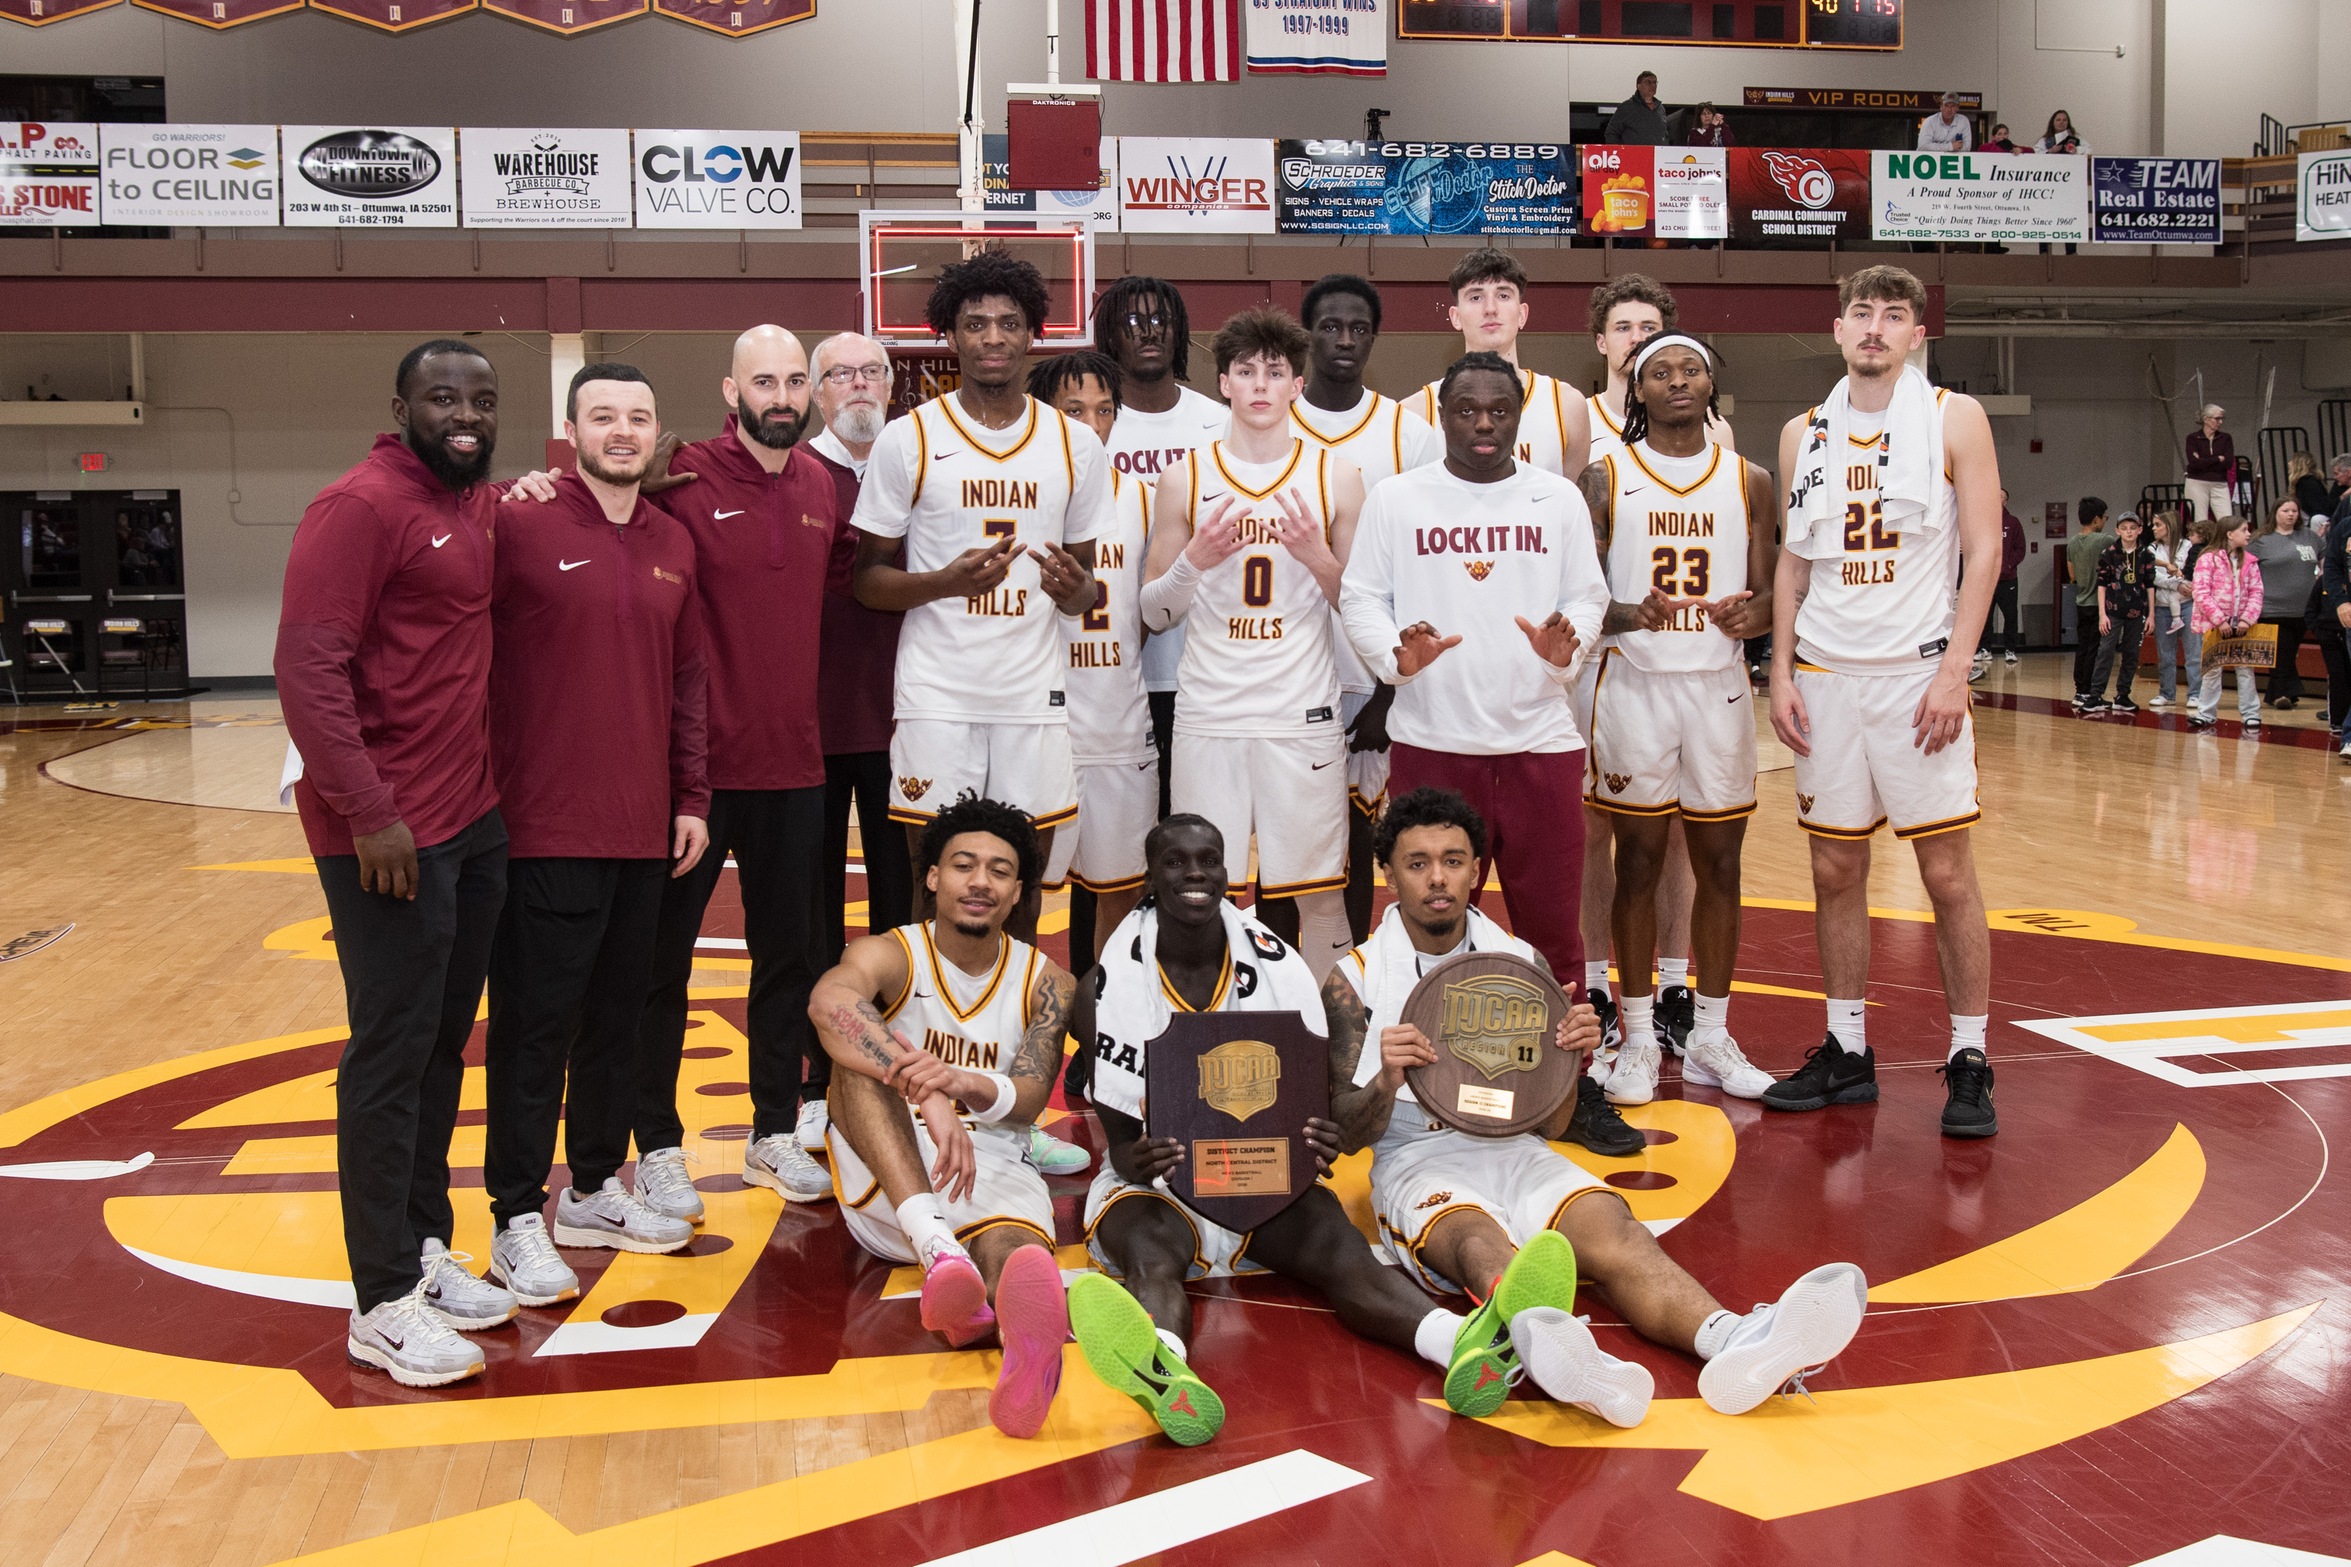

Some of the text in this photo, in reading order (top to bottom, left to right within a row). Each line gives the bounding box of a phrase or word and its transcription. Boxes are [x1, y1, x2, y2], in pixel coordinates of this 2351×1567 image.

[1283, 15, 1348, 36] 1997-1999
[1808, 92, 1919, 106] VIP ROOM
[152, 133, 226, 142] GO WARRIORS!
[0, 149, 91, 159] HALT PAVING
[107, 147, 219, 170] FLOOR
[328, 147, 410, 161] DOWNTOWN
[1305, 142, 1559, 159] 641-682-6889
[1589, 150, 1621, 168] olé
[494, 153, 599, 176] WAREHOUSE
[642, 145, 795, 183] CLOW
[1289, 163, 1386, 179] SCHROEDER
[1515, 165, 1534, 174] THE
[1888, 154, 2071, 183] NOEL Insurance
[329, 166, 411, 183] FITNESS
[1658, 168, 1685, 178] taco
[2137, 160, 2217, 189] TEAM
[108, 179, 273, 201] to CEILING
[516, 178, 579, 189] BARBECUE CO.
[1127, 178, 1268, 203] WINGER
[1309, 178, 1357, 191] Graphics
[1489, 176, 1567, 202] Stitch Doctor
[1804, 177, 1824, 201] C
[13, 185, 93, 212] STONE
[646, 188, 795, 214] VALVE CO.
[986, 193, 1026, 204] ERNET
[1285, 197, 1384, 206] SIGNS VEHICLE WRAPS
[1610, 197, 1638, 207] taco
[1907, 187, 2055, 201] A Proud Sponsor of IHCC!
[2099, 190, 2215, 208] Real Estate
[112, 208, 269, 217] INTERIOR DESIGN SHOWROOM
[289, 204, 452, 214] 203 W 4th St Ottumwa, IA 52501
[496, 199, 601, 209] BREWHOUSE
[1483, 205, 1573, 214] Custom Screen Print
[338, 215, 404, 224] 641-682-1794
[1094, 212, 1112, 220] ORG
[1294, 209, 1375, 218] BANNERS DECALS
[1486, 214, 1509, 222] Vinyl
[1521, 214, 1571, 223] Embroidery
[1611, 209, 1638, 217] john's
[1751, 209, 1847, 222] CARDINAL COMMUNITY
[1950, 217, 1973, 226] Doing
[1976, 217, 2001, 226] Things
[2005, 217, 2028, 226] Better
[2031, 218, 2053, 226] Since
[2101, 213, 2214, 227] 641.682.2221
[1281, 222, 1389, 230] WWW.SGSIGNLLC.COM
[1762, 224, 1837, 236] SCHOOL DISTRICT
[1879, 229, 1970, 238] 641-682-7533
[1991, 230, 2082, 239] 800-925-0514
[2103, 230, 2213, 240] www.TeamOttumwa.com
[1114, 449, 1162, 474] OCK
[962, 479, 1038, 510] INDIAN
[1648, 512, 1714, 537] INDIAN
[1844, 501, 1899, 552] 22
[983, 518, 1017, 578] 7
[1416, 526, 1548, 556] LOCK IT IN.
[1651, 545, 1711, 598] 23
[1842, 560, 1895, 586] HILLS
[1242, 555, 1273, 609] 0
[967, 588, 1027, 617] HILLS
[1229, 617, 1283, 640] HILLS
[1070, 641, 1121, 668] HILLS
[1445, 991, 1544, 1035] NJCAA
[923, 1028, 999, 1069] INDIAN
[1461, 1039, 1533, 1063] REGION 11
[1201, 1056, 1278, 1094] NJCAA
